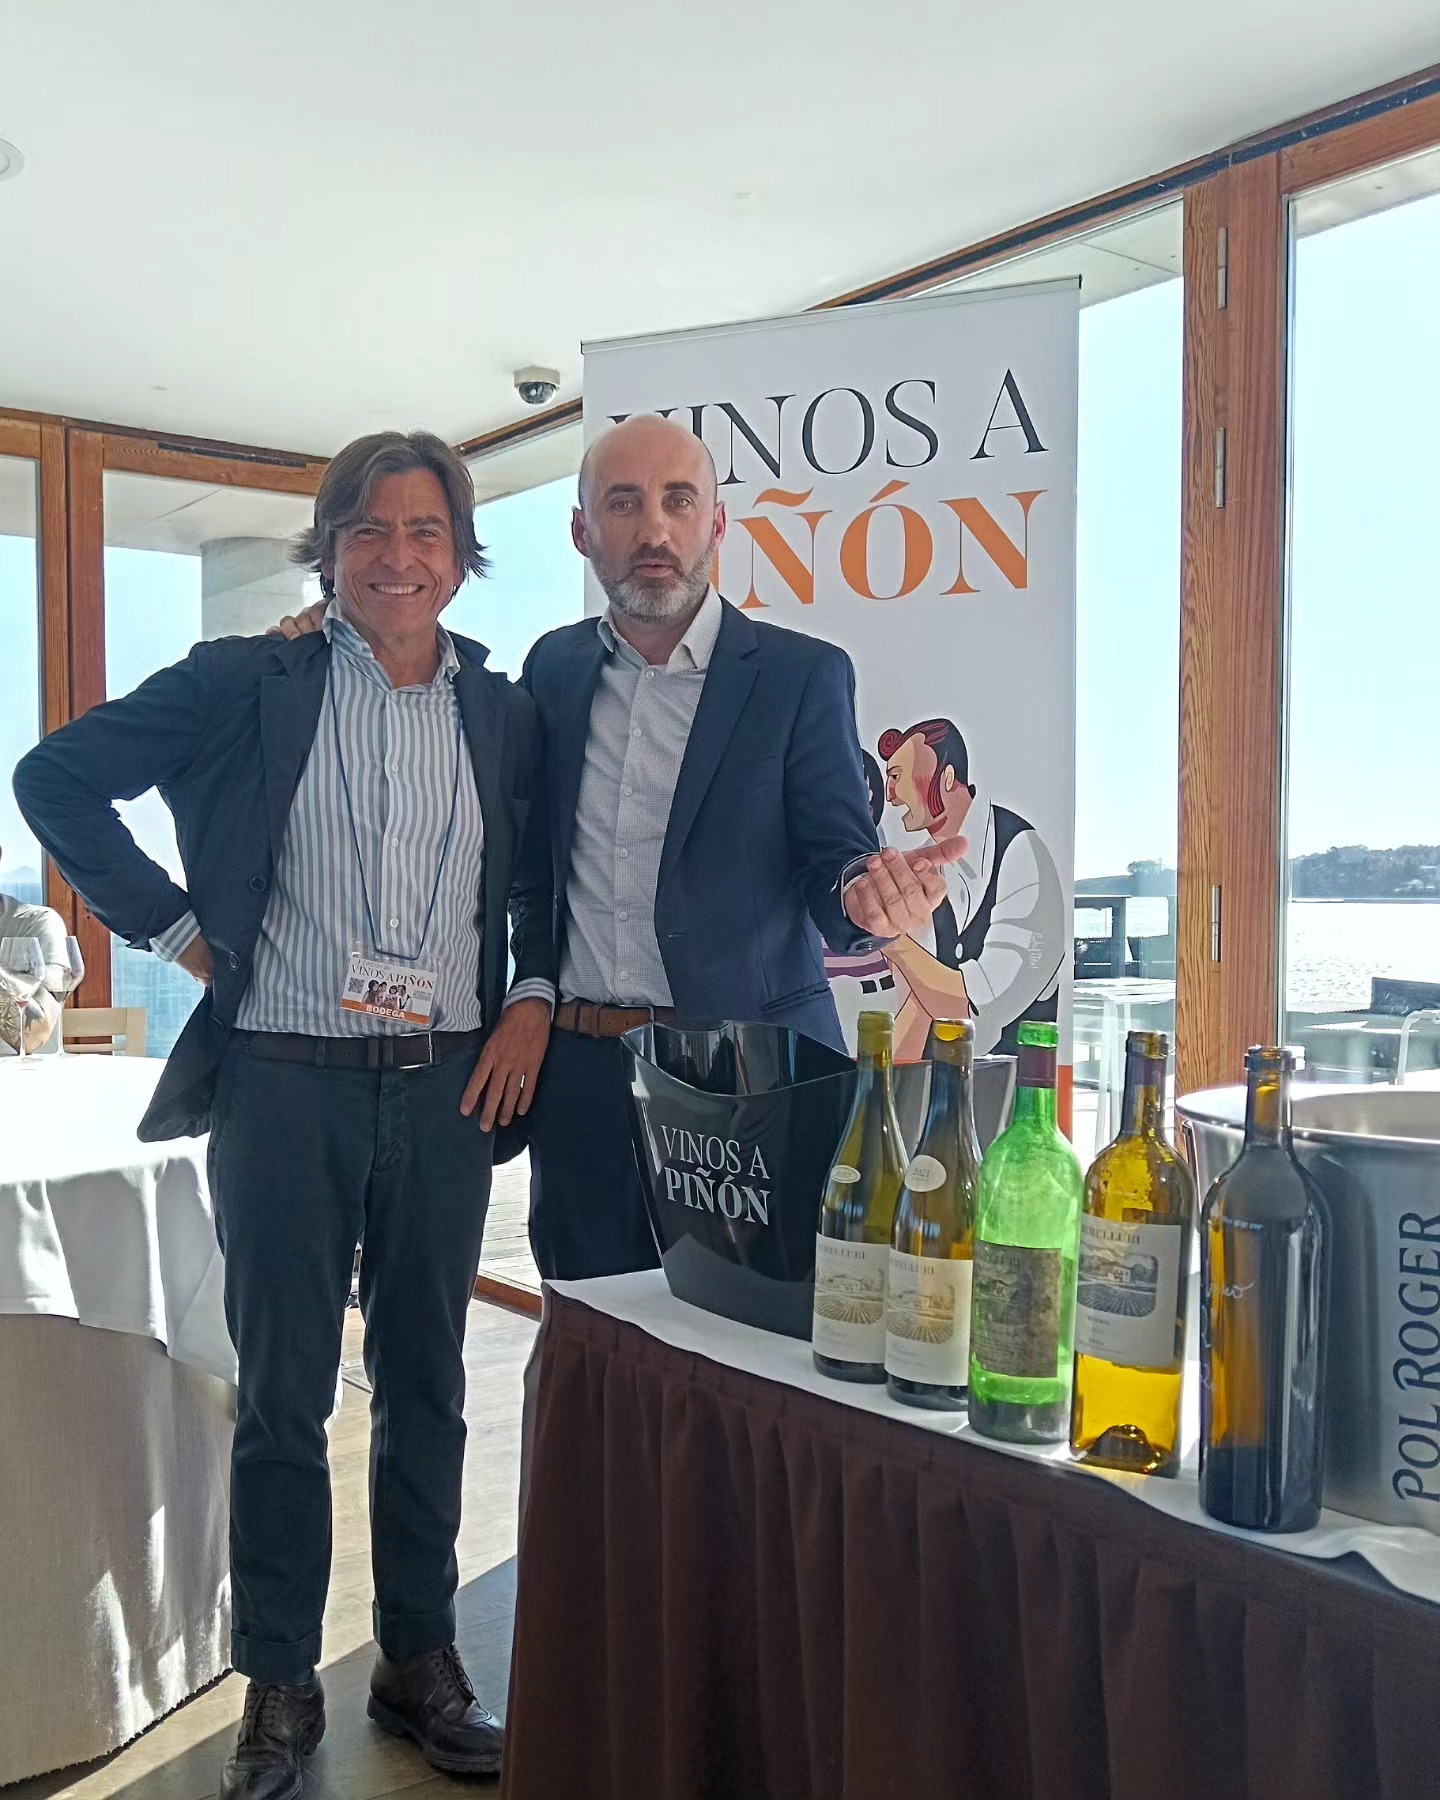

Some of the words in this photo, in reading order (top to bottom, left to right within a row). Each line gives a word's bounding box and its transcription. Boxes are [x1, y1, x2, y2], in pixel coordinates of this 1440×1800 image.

[607, 380, 939, 486] NOS
[969, 368, 1049, 460] A
[709, 479, 1049, 609] ÑÓN
[352, 964, 385, 980] VINOS
[387, 972, 394, 982] A
[396, 973, 433, 990] PIÑÓN
[366, 1004, 405, 1019] BODEGA
[661, 1125, 741, 1174] VINOS
[748, 1145, 770, 1180] A
[664, 1166, 771, 1226] PIÑÓN
[1393, 1212, 1440, 1392] ROGER
[1393, 1403, 1440, 1502] POL
